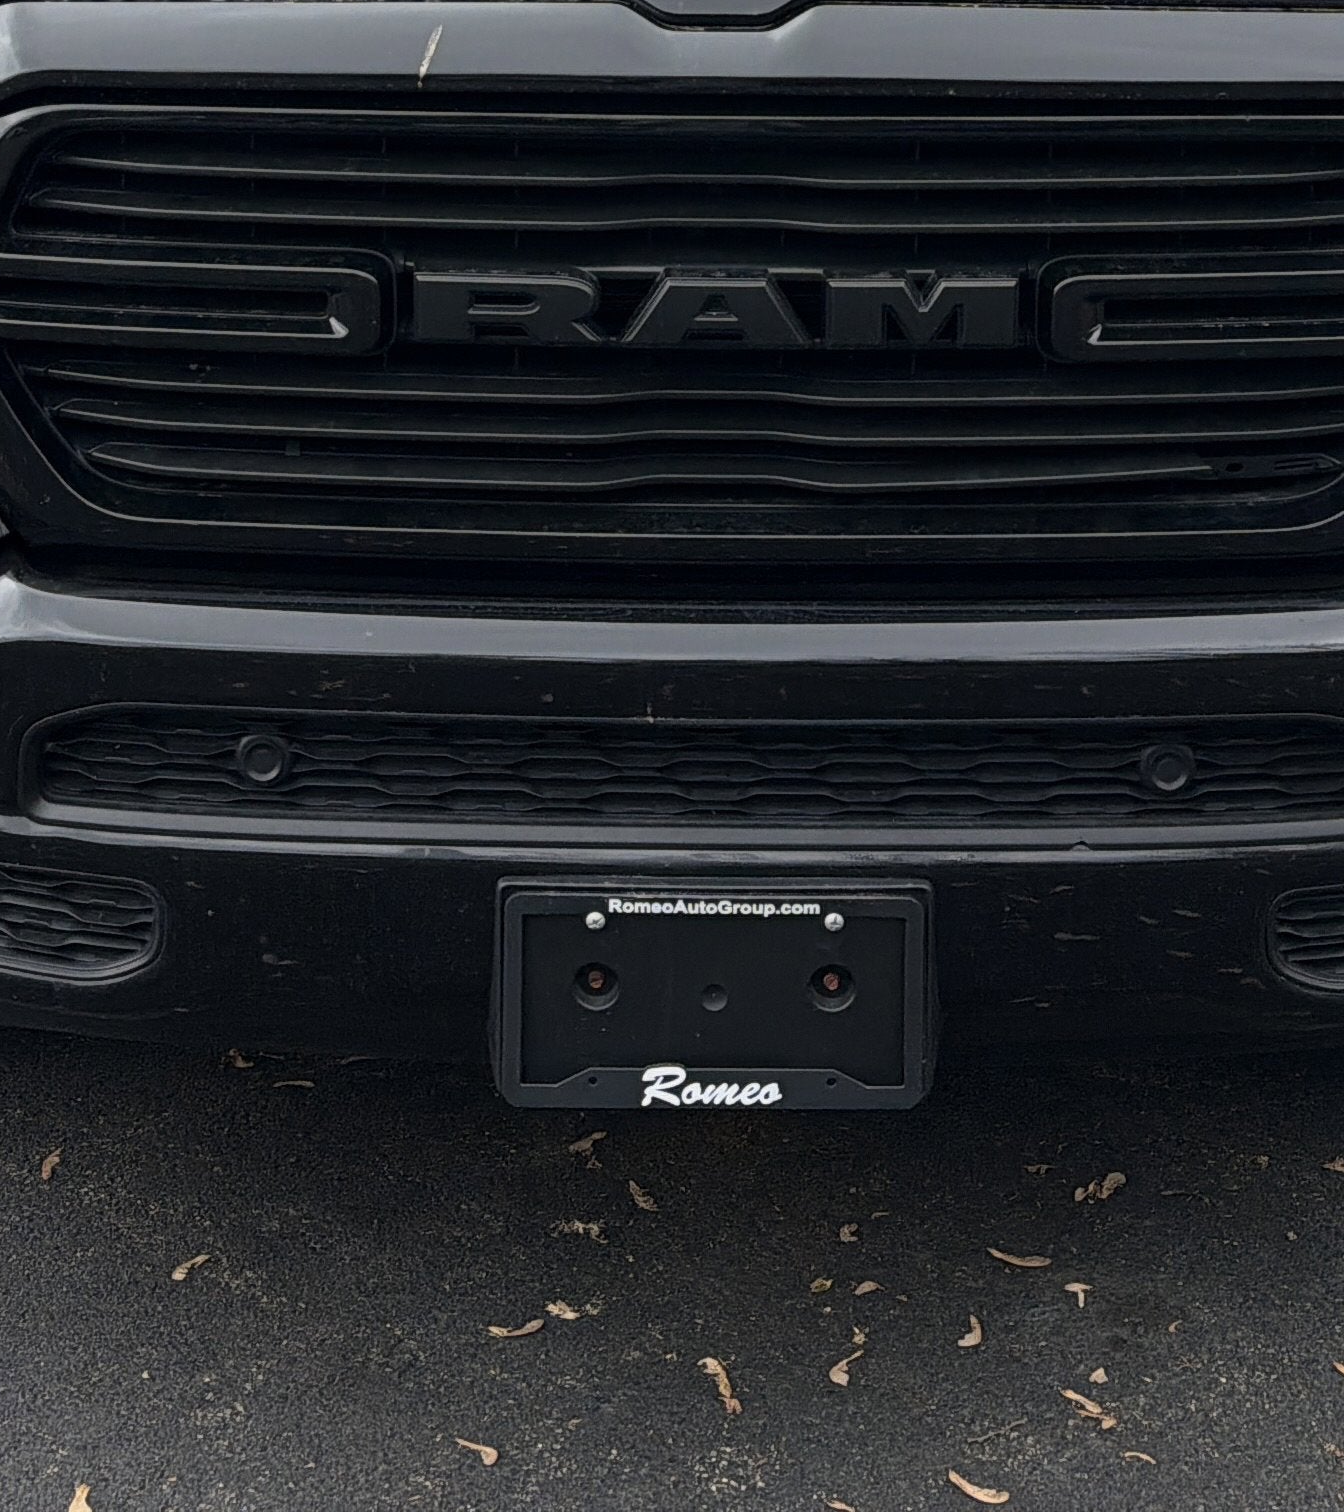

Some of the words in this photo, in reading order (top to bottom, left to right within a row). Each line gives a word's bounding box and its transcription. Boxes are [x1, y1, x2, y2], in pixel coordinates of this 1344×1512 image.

[415, 268, 1019, 348] RAM
[608, 899, 821, 917] RomeoAutoGroup.com
[641, 1066, 783, 1106] Romeo
